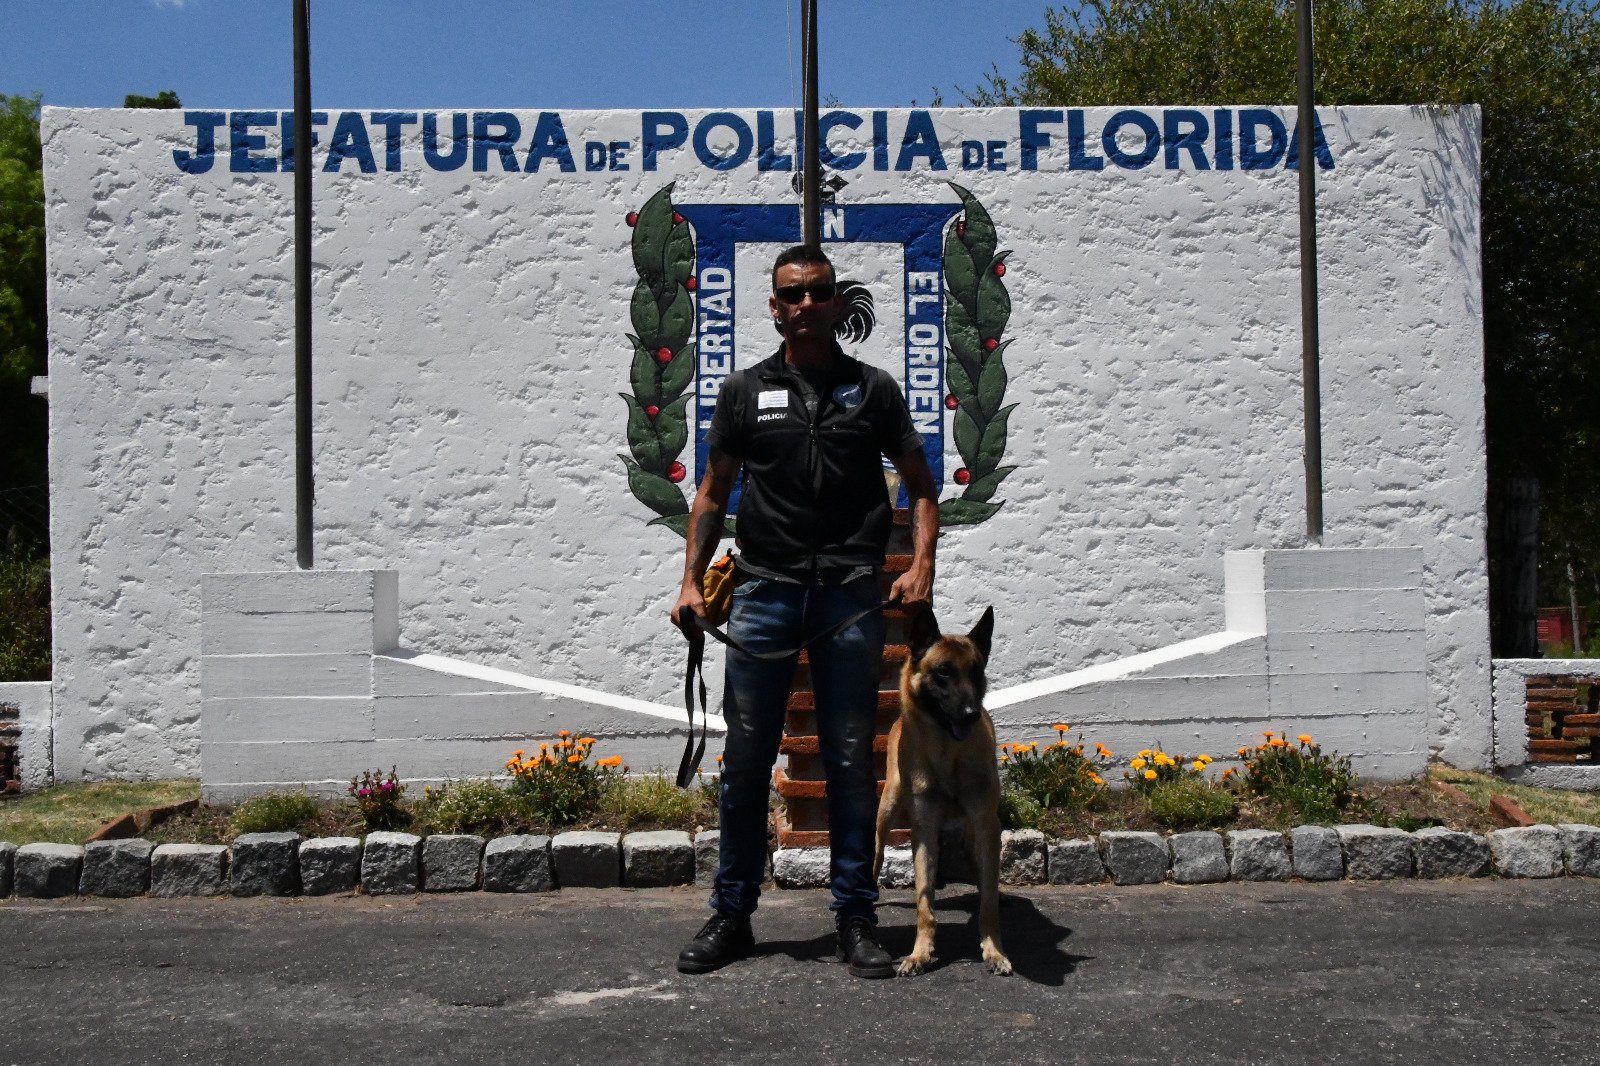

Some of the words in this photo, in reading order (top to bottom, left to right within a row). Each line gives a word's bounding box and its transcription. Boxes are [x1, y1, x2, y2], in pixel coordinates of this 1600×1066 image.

[173, 110, 575, 173] JEFATURA
[586, 142, 629, 171] DE
[642, 109, 947, 171] POLICIA
[963, 140, 1007, 170] DE
[1020, 108, 1335, 171] FLORIDA
[907, 271, 939, 316] EL
[699, 267, 733, 430] IBERTAD
[908, 323, 940, 434] ORDEN
